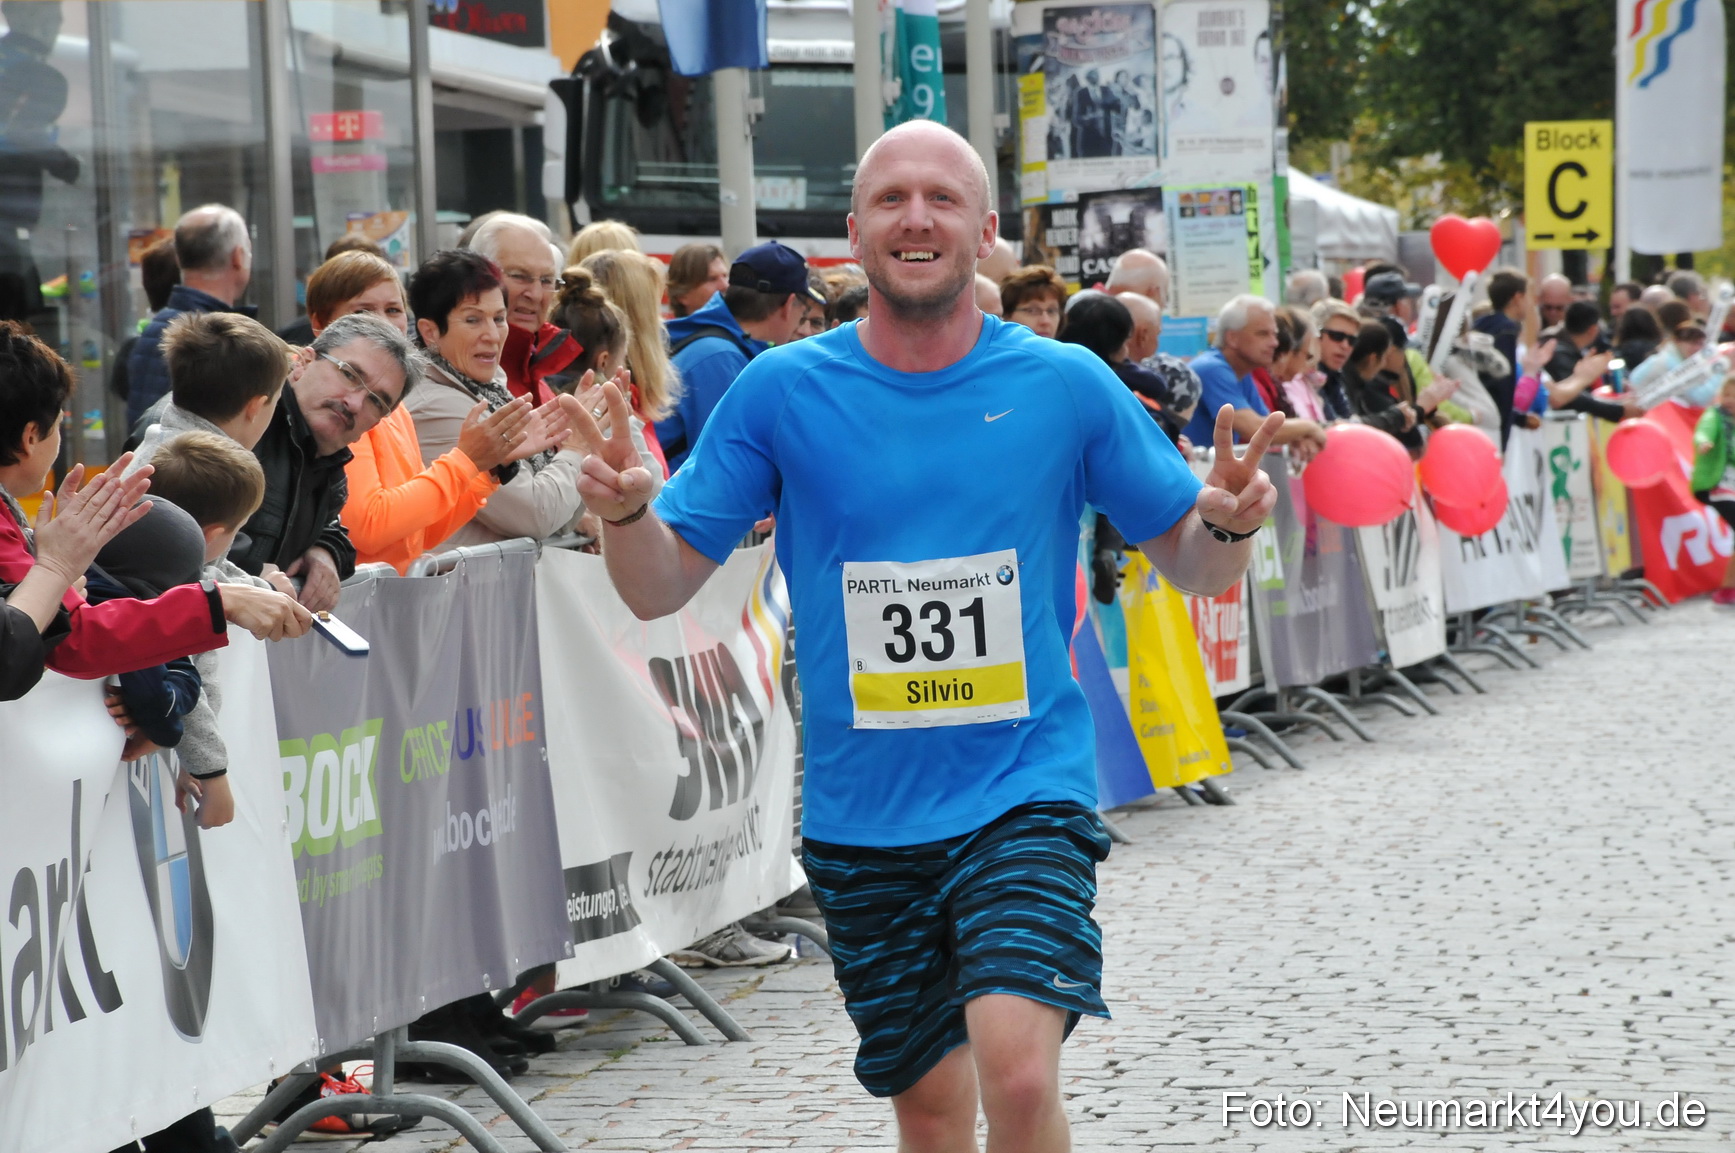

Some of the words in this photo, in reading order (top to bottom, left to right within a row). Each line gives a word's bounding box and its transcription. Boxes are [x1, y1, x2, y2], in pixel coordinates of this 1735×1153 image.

[1536, 128, 1601, 150] Block
[1547, 161, 1588, 220] C
[847, 579, 903, 594] PARTL
[907, 572, 991, 592] Neumarkt
[882, 596, 988, 663] 331
[856, 660, 863, 671] B
[906, 678, 974, 705] Silvio
